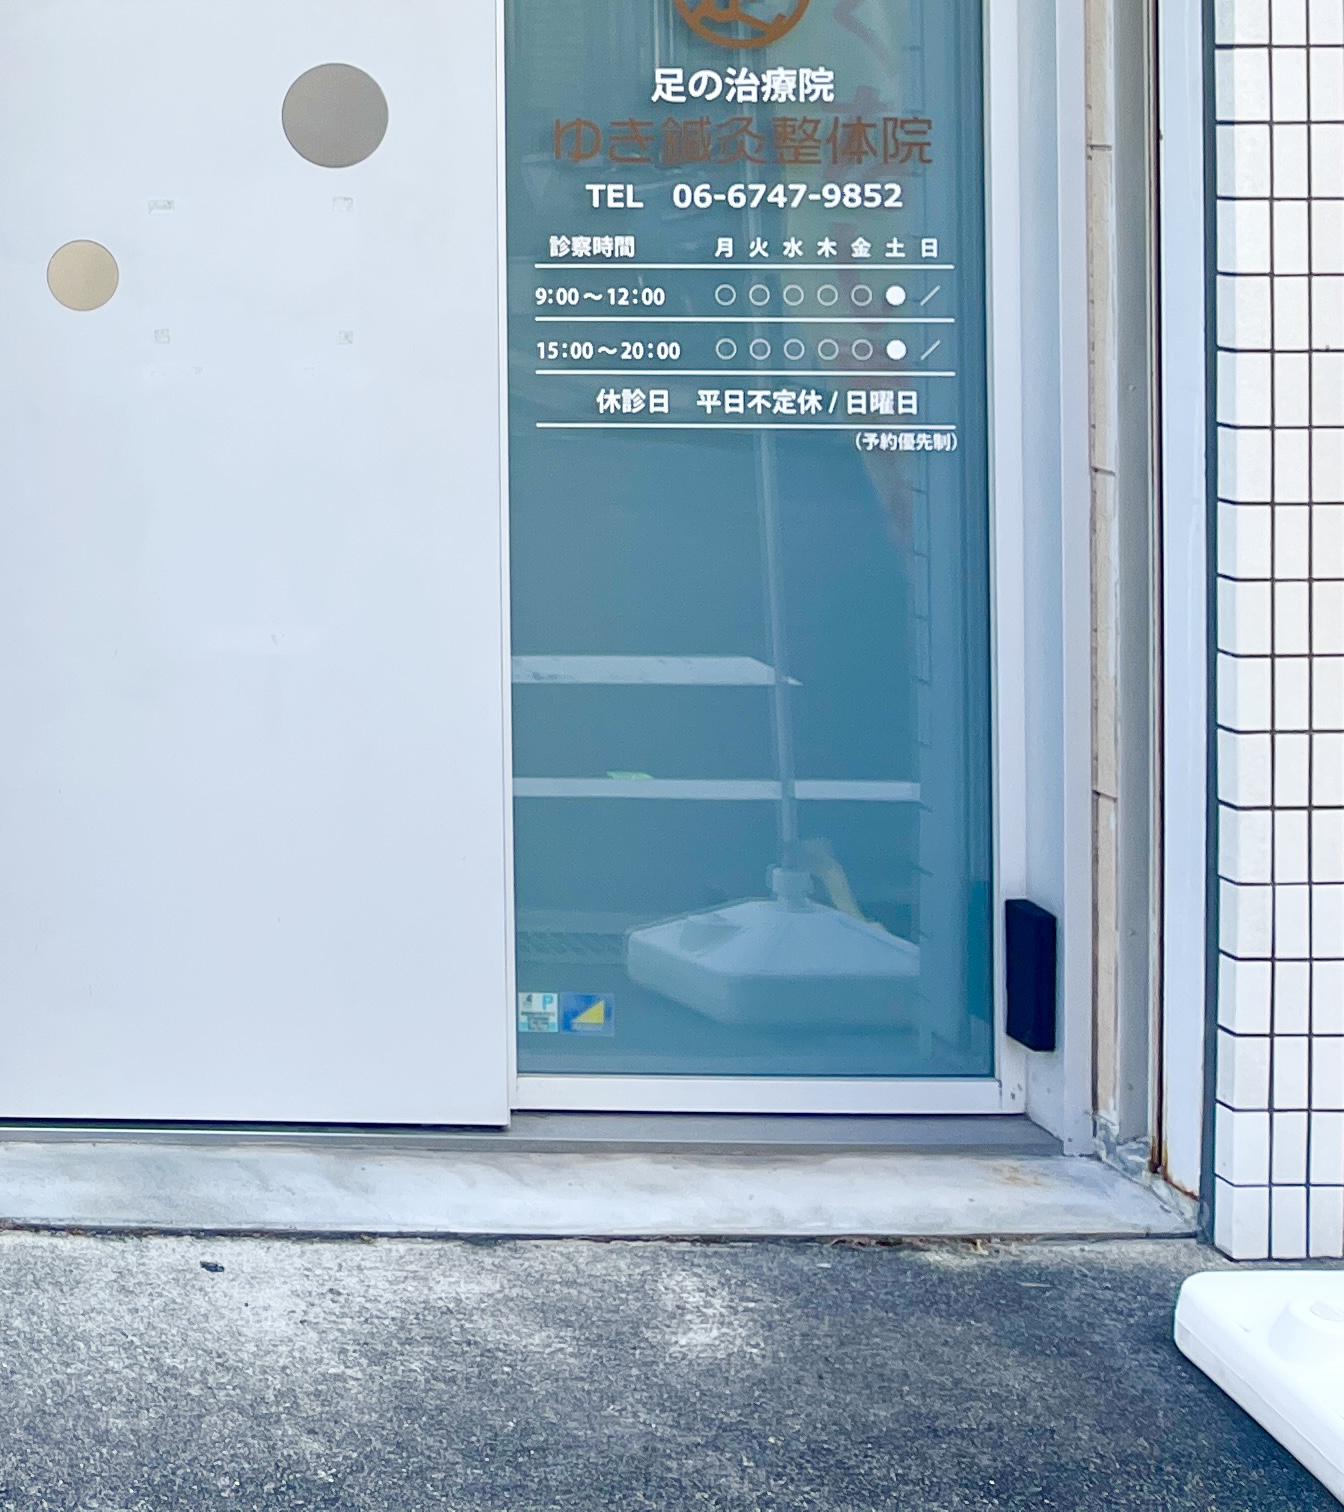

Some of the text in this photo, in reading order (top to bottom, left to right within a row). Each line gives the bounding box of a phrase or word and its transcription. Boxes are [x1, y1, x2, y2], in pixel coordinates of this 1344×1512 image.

[650, 66, 836, 104] 足の治療院
[553, 115, 934, 166] ゆき鍼灸整体院
[585, 183, 904, 209] TEL 06-6747-9852
[548, 235, 939, 259] 診察時間 月 火 水 木 金 土 日
[596, 389, 670, 415] 休診日
